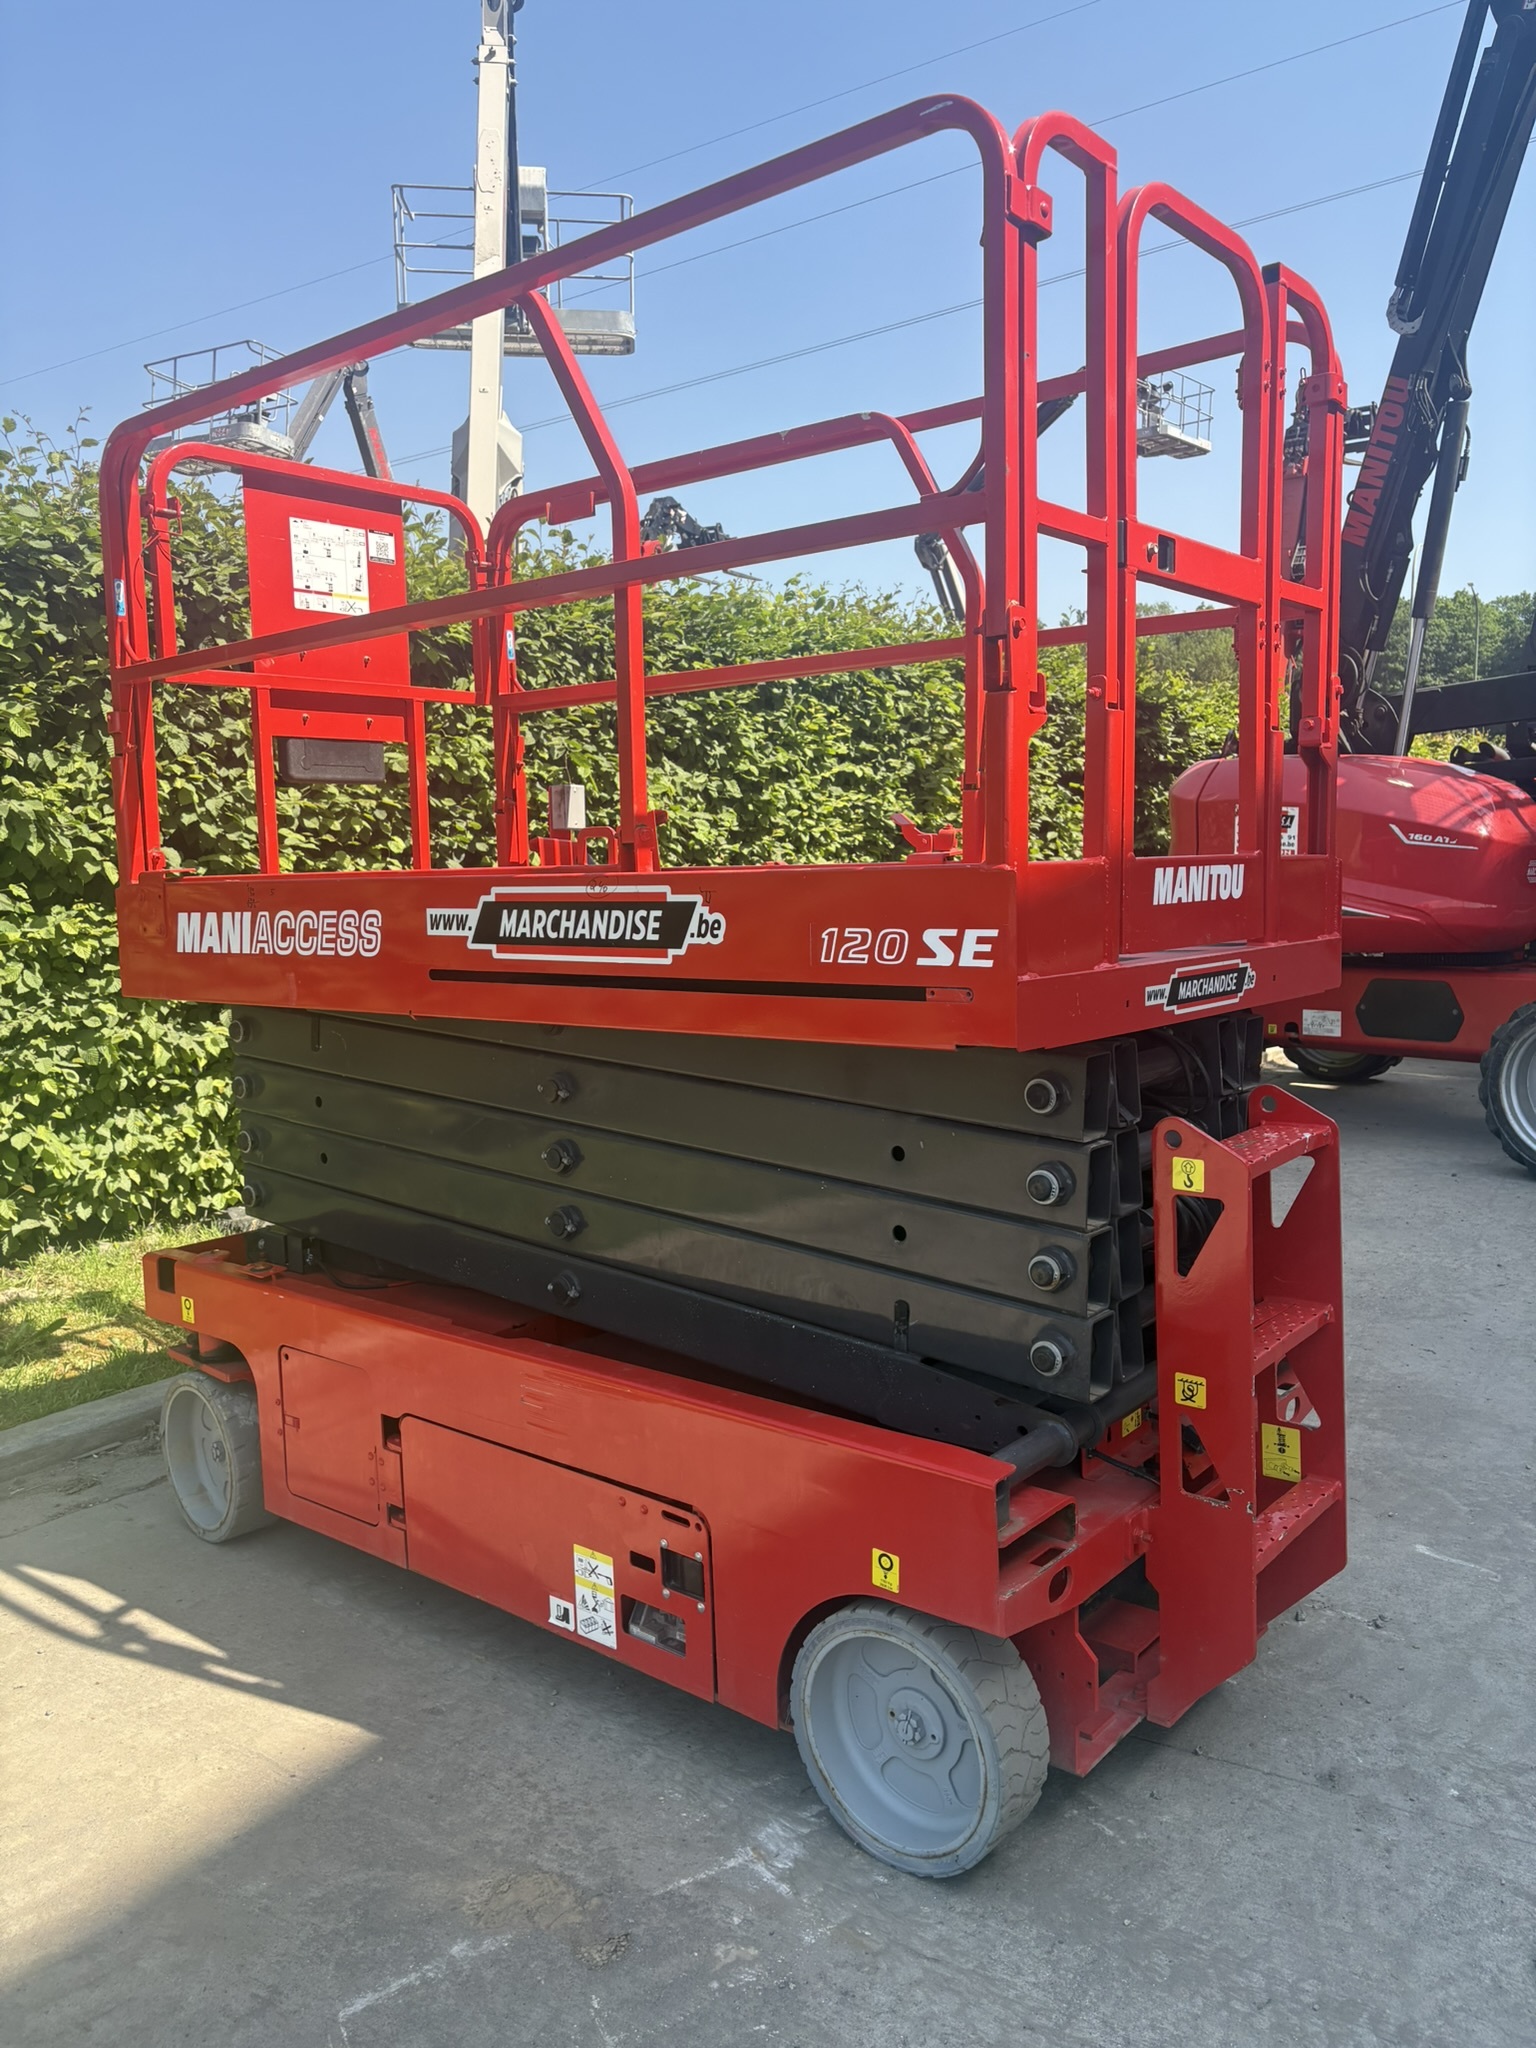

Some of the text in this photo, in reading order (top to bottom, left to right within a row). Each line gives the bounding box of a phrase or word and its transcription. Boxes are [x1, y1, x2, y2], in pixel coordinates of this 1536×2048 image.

[1342, 375, 1410, 547] MANITOU
[1408, 833, 1433, 841] 160
[1152, 863, 1245, 906] MANITOU
[176, 909, 382, 958] MANIACCESS
[820, 927, 1000, 968] 120 SE
